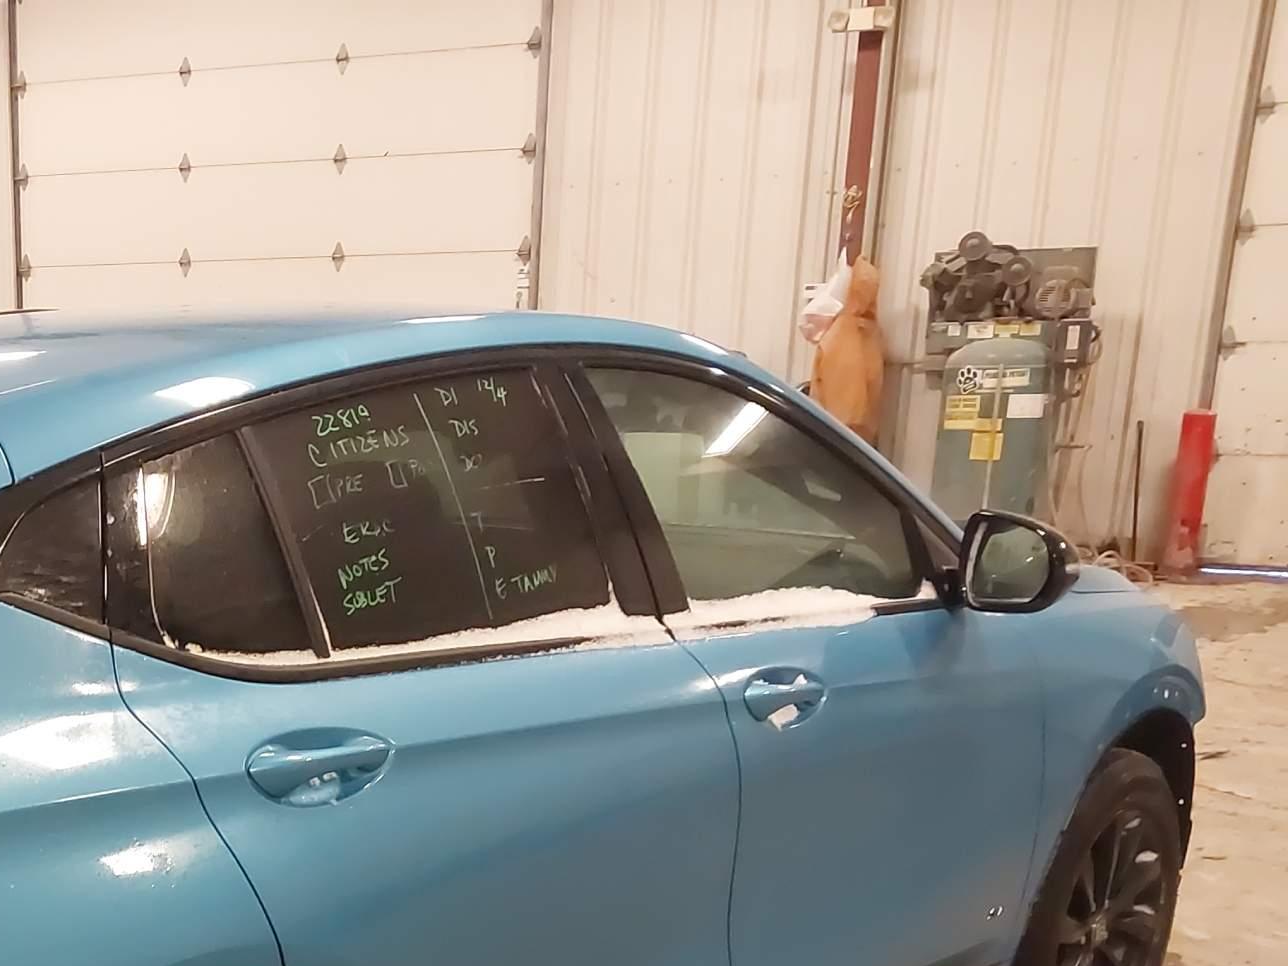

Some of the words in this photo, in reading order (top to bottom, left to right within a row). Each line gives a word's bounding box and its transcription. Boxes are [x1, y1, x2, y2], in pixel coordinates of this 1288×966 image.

[448, 418, 479, 438] DIS
[308, 424, 410, 468] CITIZENS
[337, 548, 390, 590] NOTES
[485, 546, 496, 569] P
